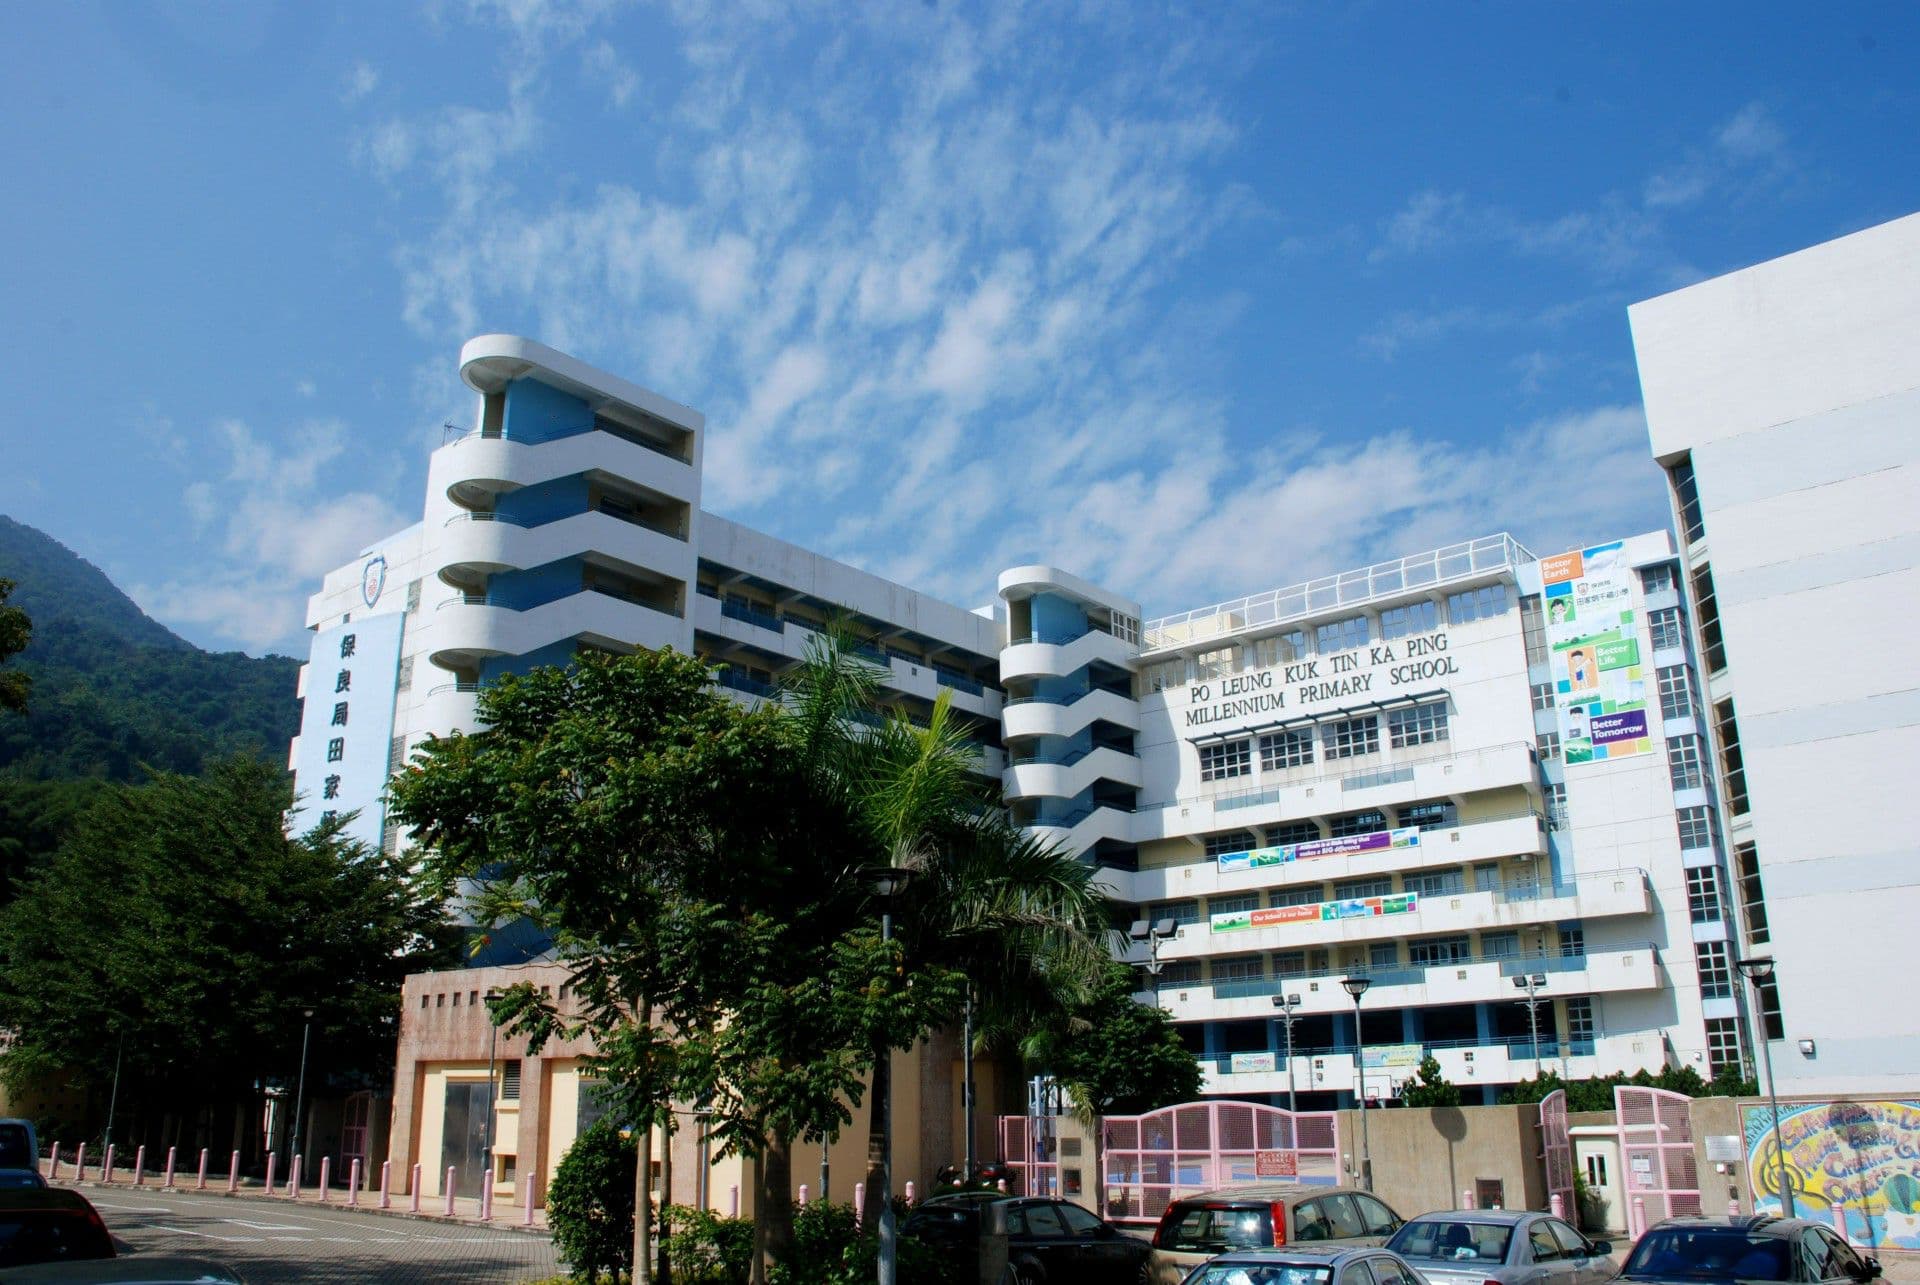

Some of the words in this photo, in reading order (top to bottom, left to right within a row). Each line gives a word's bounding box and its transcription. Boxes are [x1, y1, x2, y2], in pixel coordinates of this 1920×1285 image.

[1543, 559, 1572, 570] Better
[1544, 568, 1569, 578] Earth
[1597, 645, 1628, 656] Better
[1598, 656, 1616, 665] Life
[1190, 685, 1210, 703] PO
[1222, 671, 1272, 697] LEUNG
[1285, 661, 1319, 684] KUK
[1330, 652, 1358, 674] TIN
[1370, 645, 1395, 666] KA
[1407, 634, 1448, 658] PING
[1186, 692, 1285, 727] MILLENNIUM
[1299, 673, 1372, 704] PRIMARY
[1390, 656, 1459, 686] SCHOOL
[1592, 719, 1623, 729] Better
[1593, 725, 1643, 739] Tomorrow
